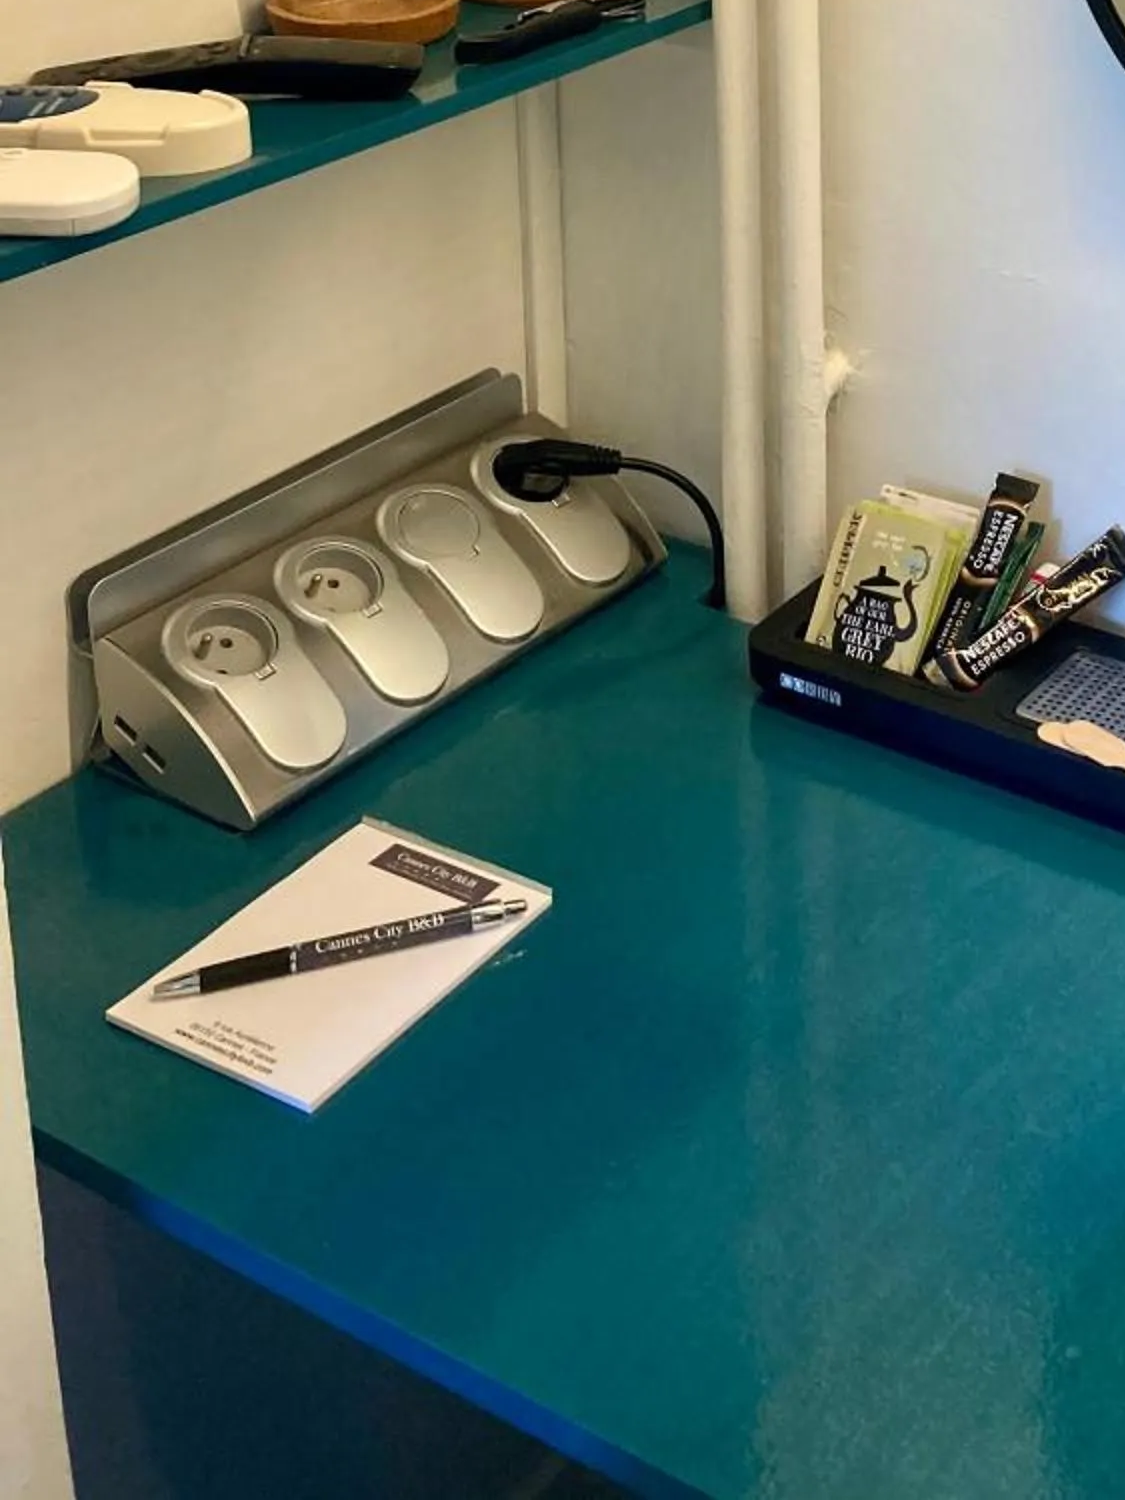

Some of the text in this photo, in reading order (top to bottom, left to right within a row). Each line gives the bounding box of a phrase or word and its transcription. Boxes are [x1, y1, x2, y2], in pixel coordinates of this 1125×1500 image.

[973, 510, 1004, 569] ESPRESSO
[841, 627, 887, 651] GREY
[971, 631, 1025, 675] ESPRESSO
[315, 912, 445, 953] Cannes City B&B
